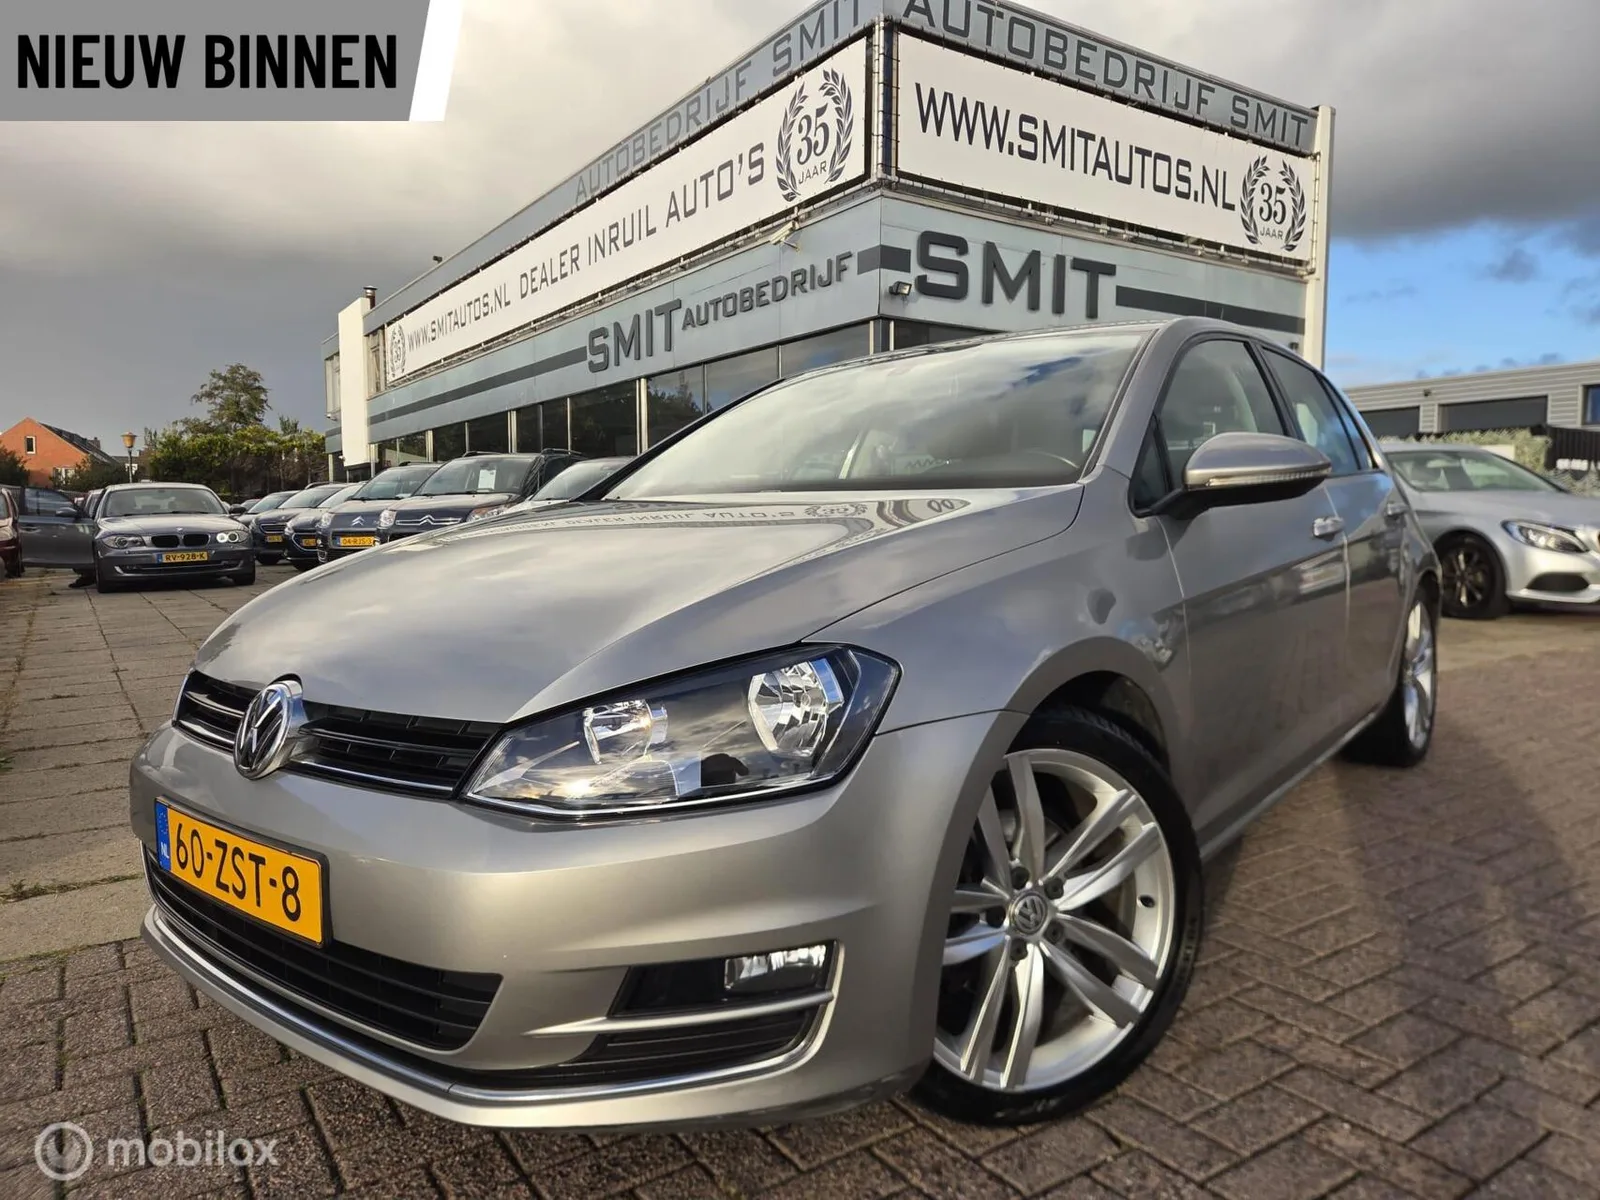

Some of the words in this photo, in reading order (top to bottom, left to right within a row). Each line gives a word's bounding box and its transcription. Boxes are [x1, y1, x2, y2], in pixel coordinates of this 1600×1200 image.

[903, 0, 1215, 115] AUTOBEDRIJF
[1230, 94, 1308, 146] SMIT
[575, 61, 752, 203] AUTOBEDRIJF
[797, 102, 830, 166] 35
[798, 160, 827, 185] JAAR
[915, 82, 1236, 211] WWW.SMITAUTOS.NL
[407, 282, 512, 352] WWW.SMITAUTOS.NL
[519, 243, 580, 300] DEALER
[587, 205, 657, 266] INRUIL
[665, 142, 765, 228] AUTO'S
[1259, 182, 1287, 225] 35
[1260, 227, 1285, 240] JAAR
[587, 298, 682, 374] SMIT
[681, 251, 853, 331] AUTOBEDRIJF
[915, 230, 1117, 319] SMIT
[175, 823, 302, 922] 60-ZST-8
